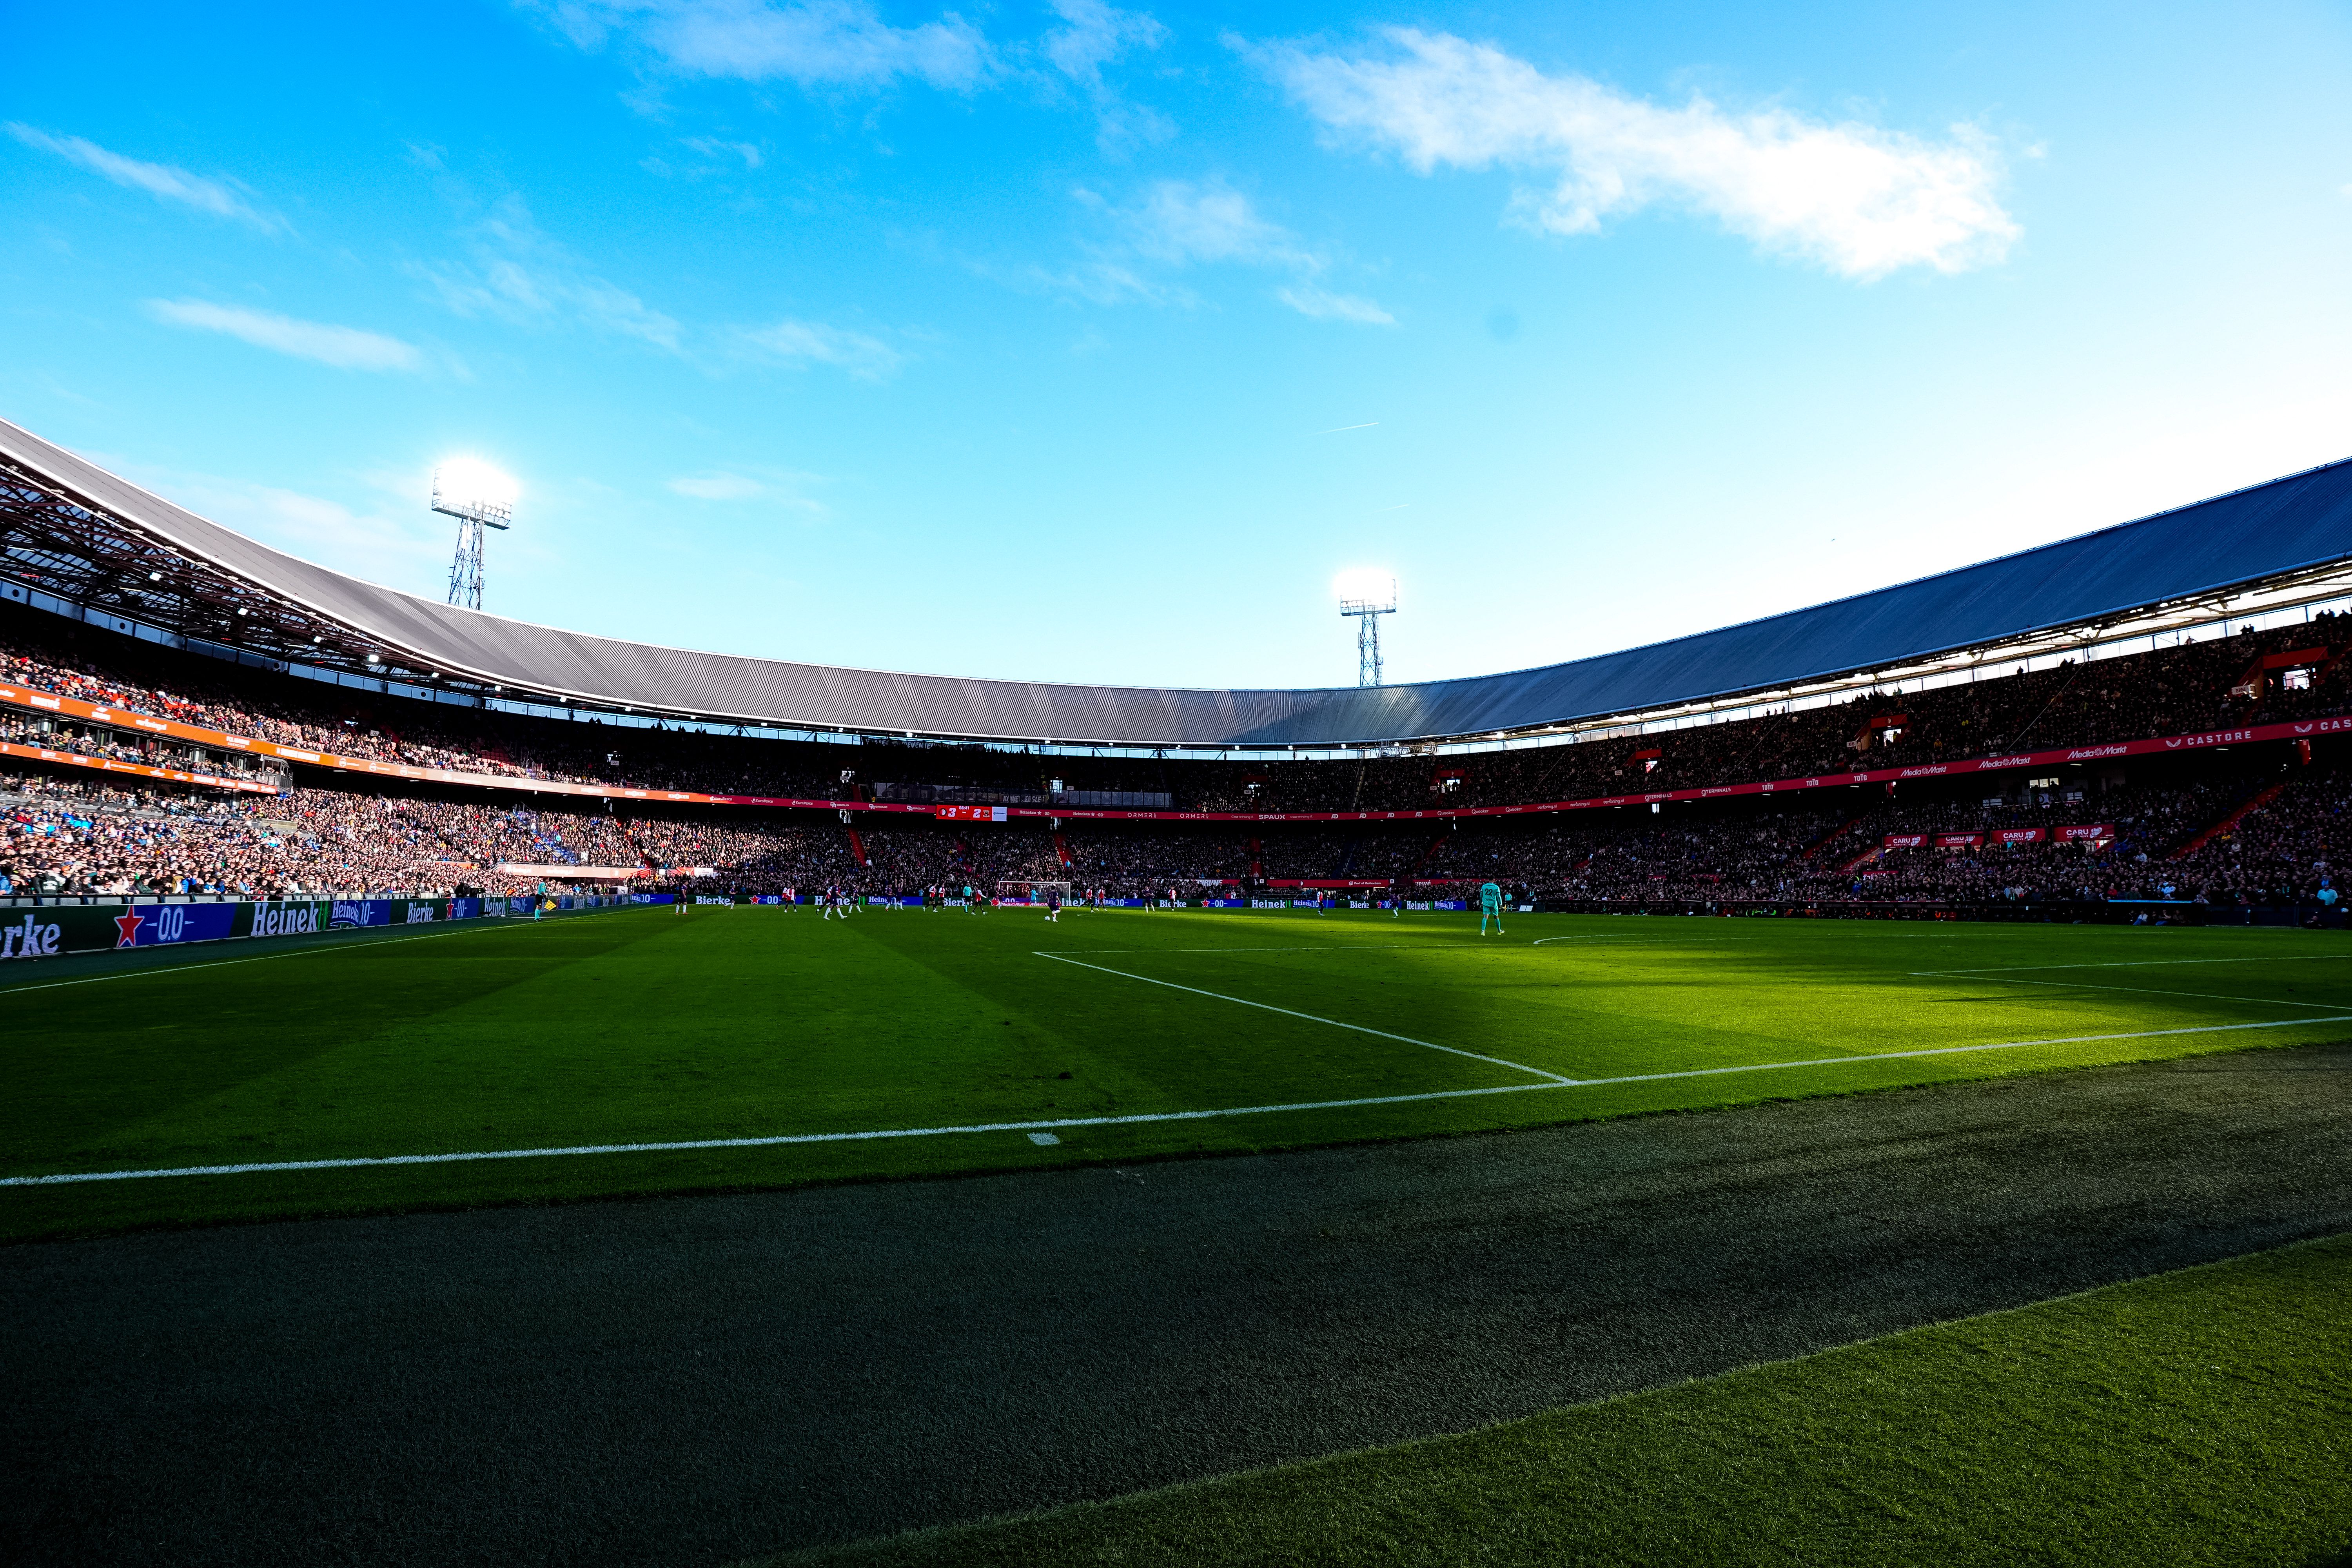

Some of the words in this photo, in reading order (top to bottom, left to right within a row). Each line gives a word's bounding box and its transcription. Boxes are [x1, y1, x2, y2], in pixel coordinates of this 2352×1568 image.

[2320, 719, 2352, 730] CAS
[2187, 731, 2251, 745] CASTORE
[1854, 773, 1867, 782] TOTO
[1701, 787, 1731, 797] QTERMINALS
[948, 808, 956, 817] 3
[973, 809, 981, 818] 2
[695, 896, 731, 905] Bierke
[767, 896, 778, 904] 0.0
[1251, 900, 1286, 908] Heinek
[483, 897, 506, 916] Heinek
[1406, 901, 1429, 910] Heinek
[407, 902, 434, 923] Bierke
[251, 901, 319, 936] Heinek
[158, 907, 183, 941] 0.0
